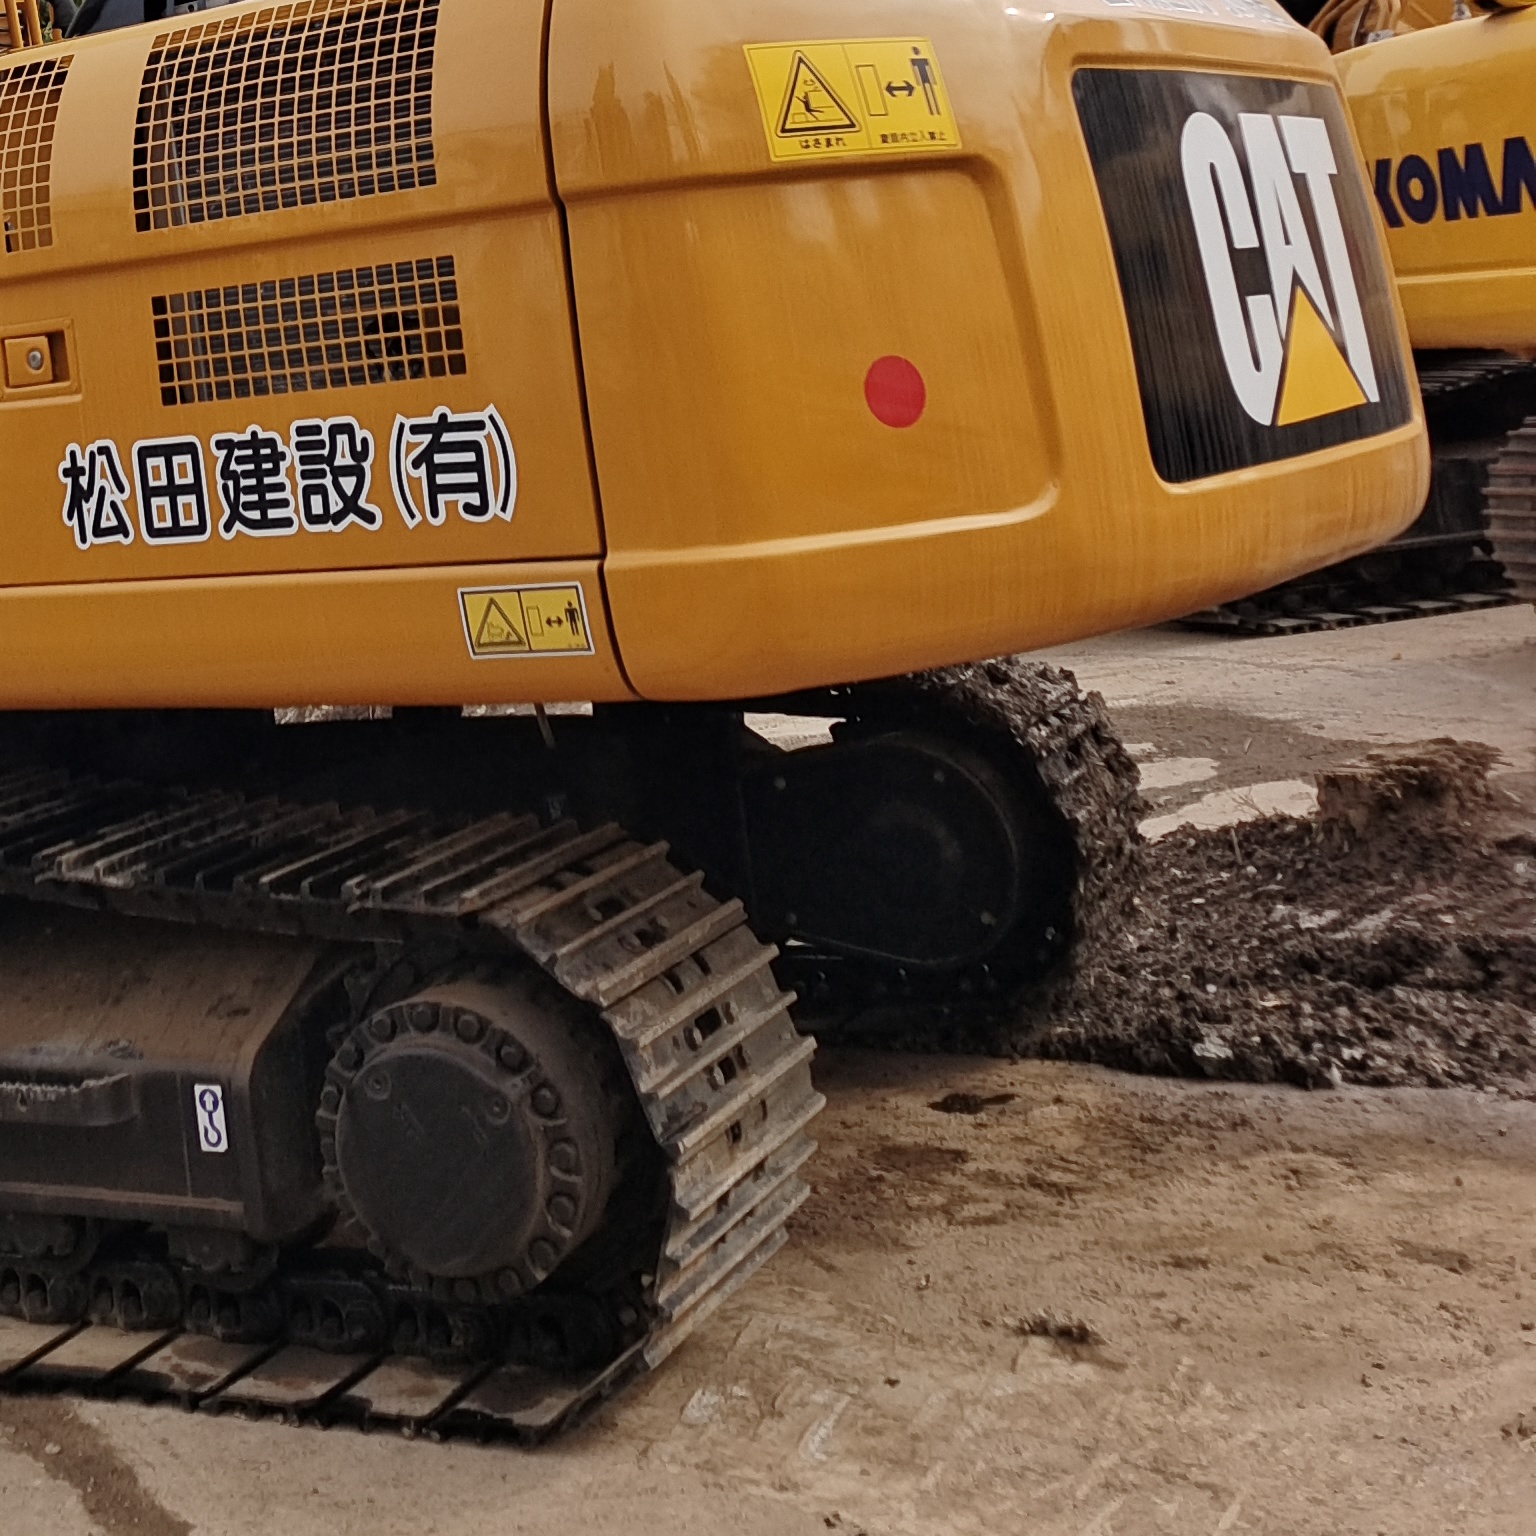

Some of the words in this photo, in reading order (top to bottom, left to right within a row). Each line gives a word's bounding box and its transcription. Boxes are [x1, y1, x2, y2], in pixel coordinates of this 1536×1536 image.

[1180, 112, 1380, 425] CAT
[65, 404, 515, 550] 松田建設(有)
